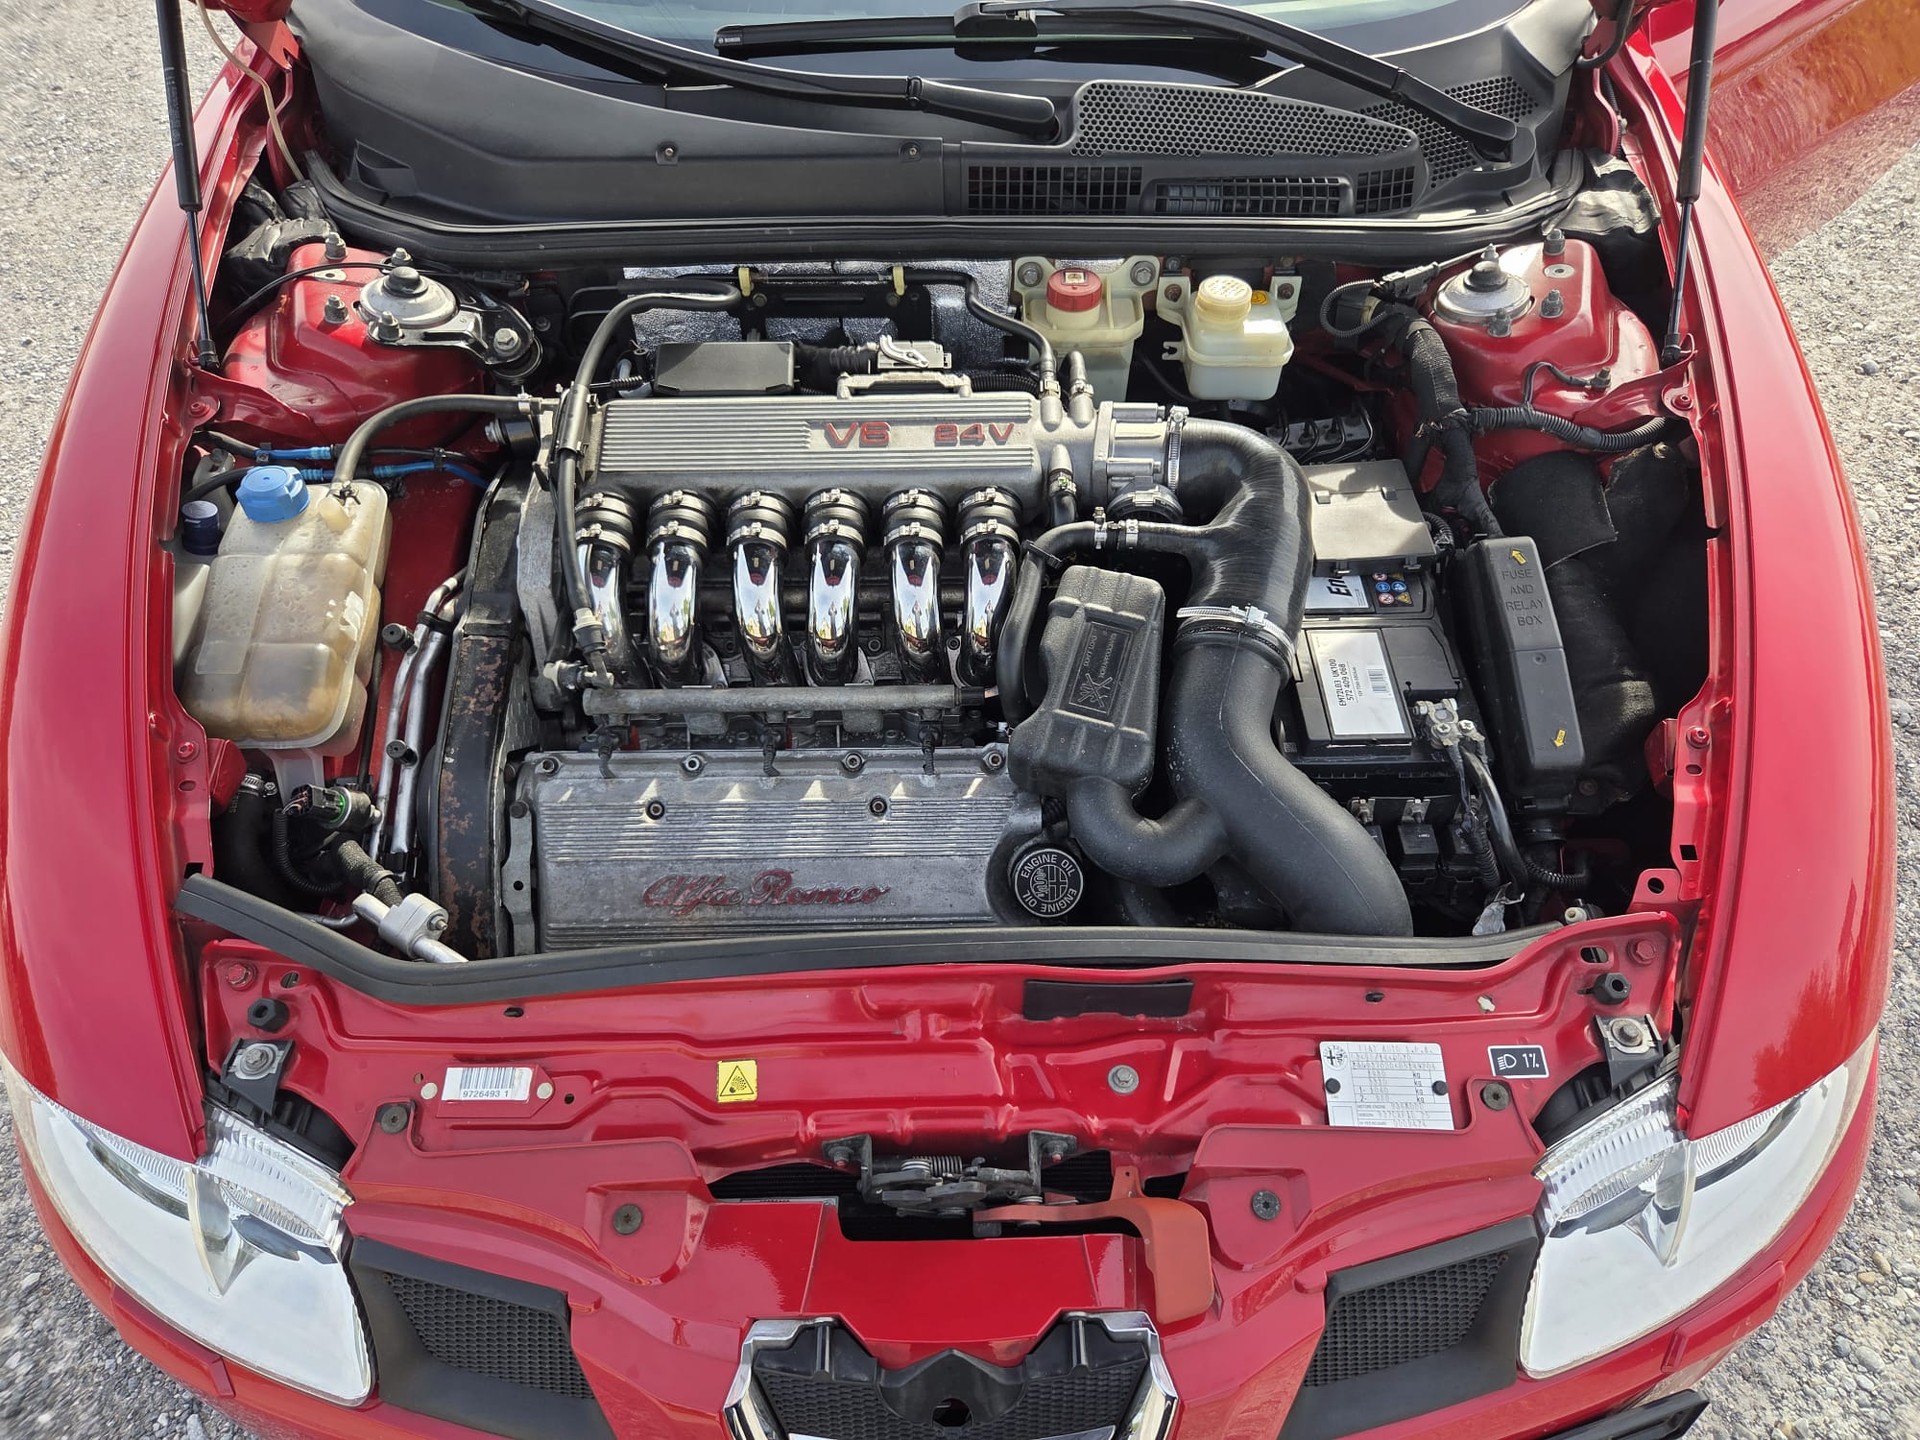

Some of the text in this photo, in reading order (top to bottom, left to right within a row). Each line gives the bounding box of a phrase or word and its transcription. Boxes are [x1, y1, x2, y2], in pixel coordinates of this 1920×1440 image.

[824, 421, 1015, 448] V6 24V
[1502, 569, 1533, 580] FUSE
[1326, 575, 1353, 597] En
[1510, 584, 1534, 595] AND
[1505, 599, 1544, 612] RELAY
[1516, 615, 1543, 626] BOX
[1328, 658, 1340, 678] UK100
[1338, 663, 1355, 701] 572 409 068
[1021, 854, 1076, 879] ENGINE OIL
[643, 868, 891, 917] Alfa Romeo
[1022, 888, 1077, 913] ENGINE OIL
[1521, 1053, 1540, 1068] 1%
[462, 1090, 509, 1098] 9726493 1
